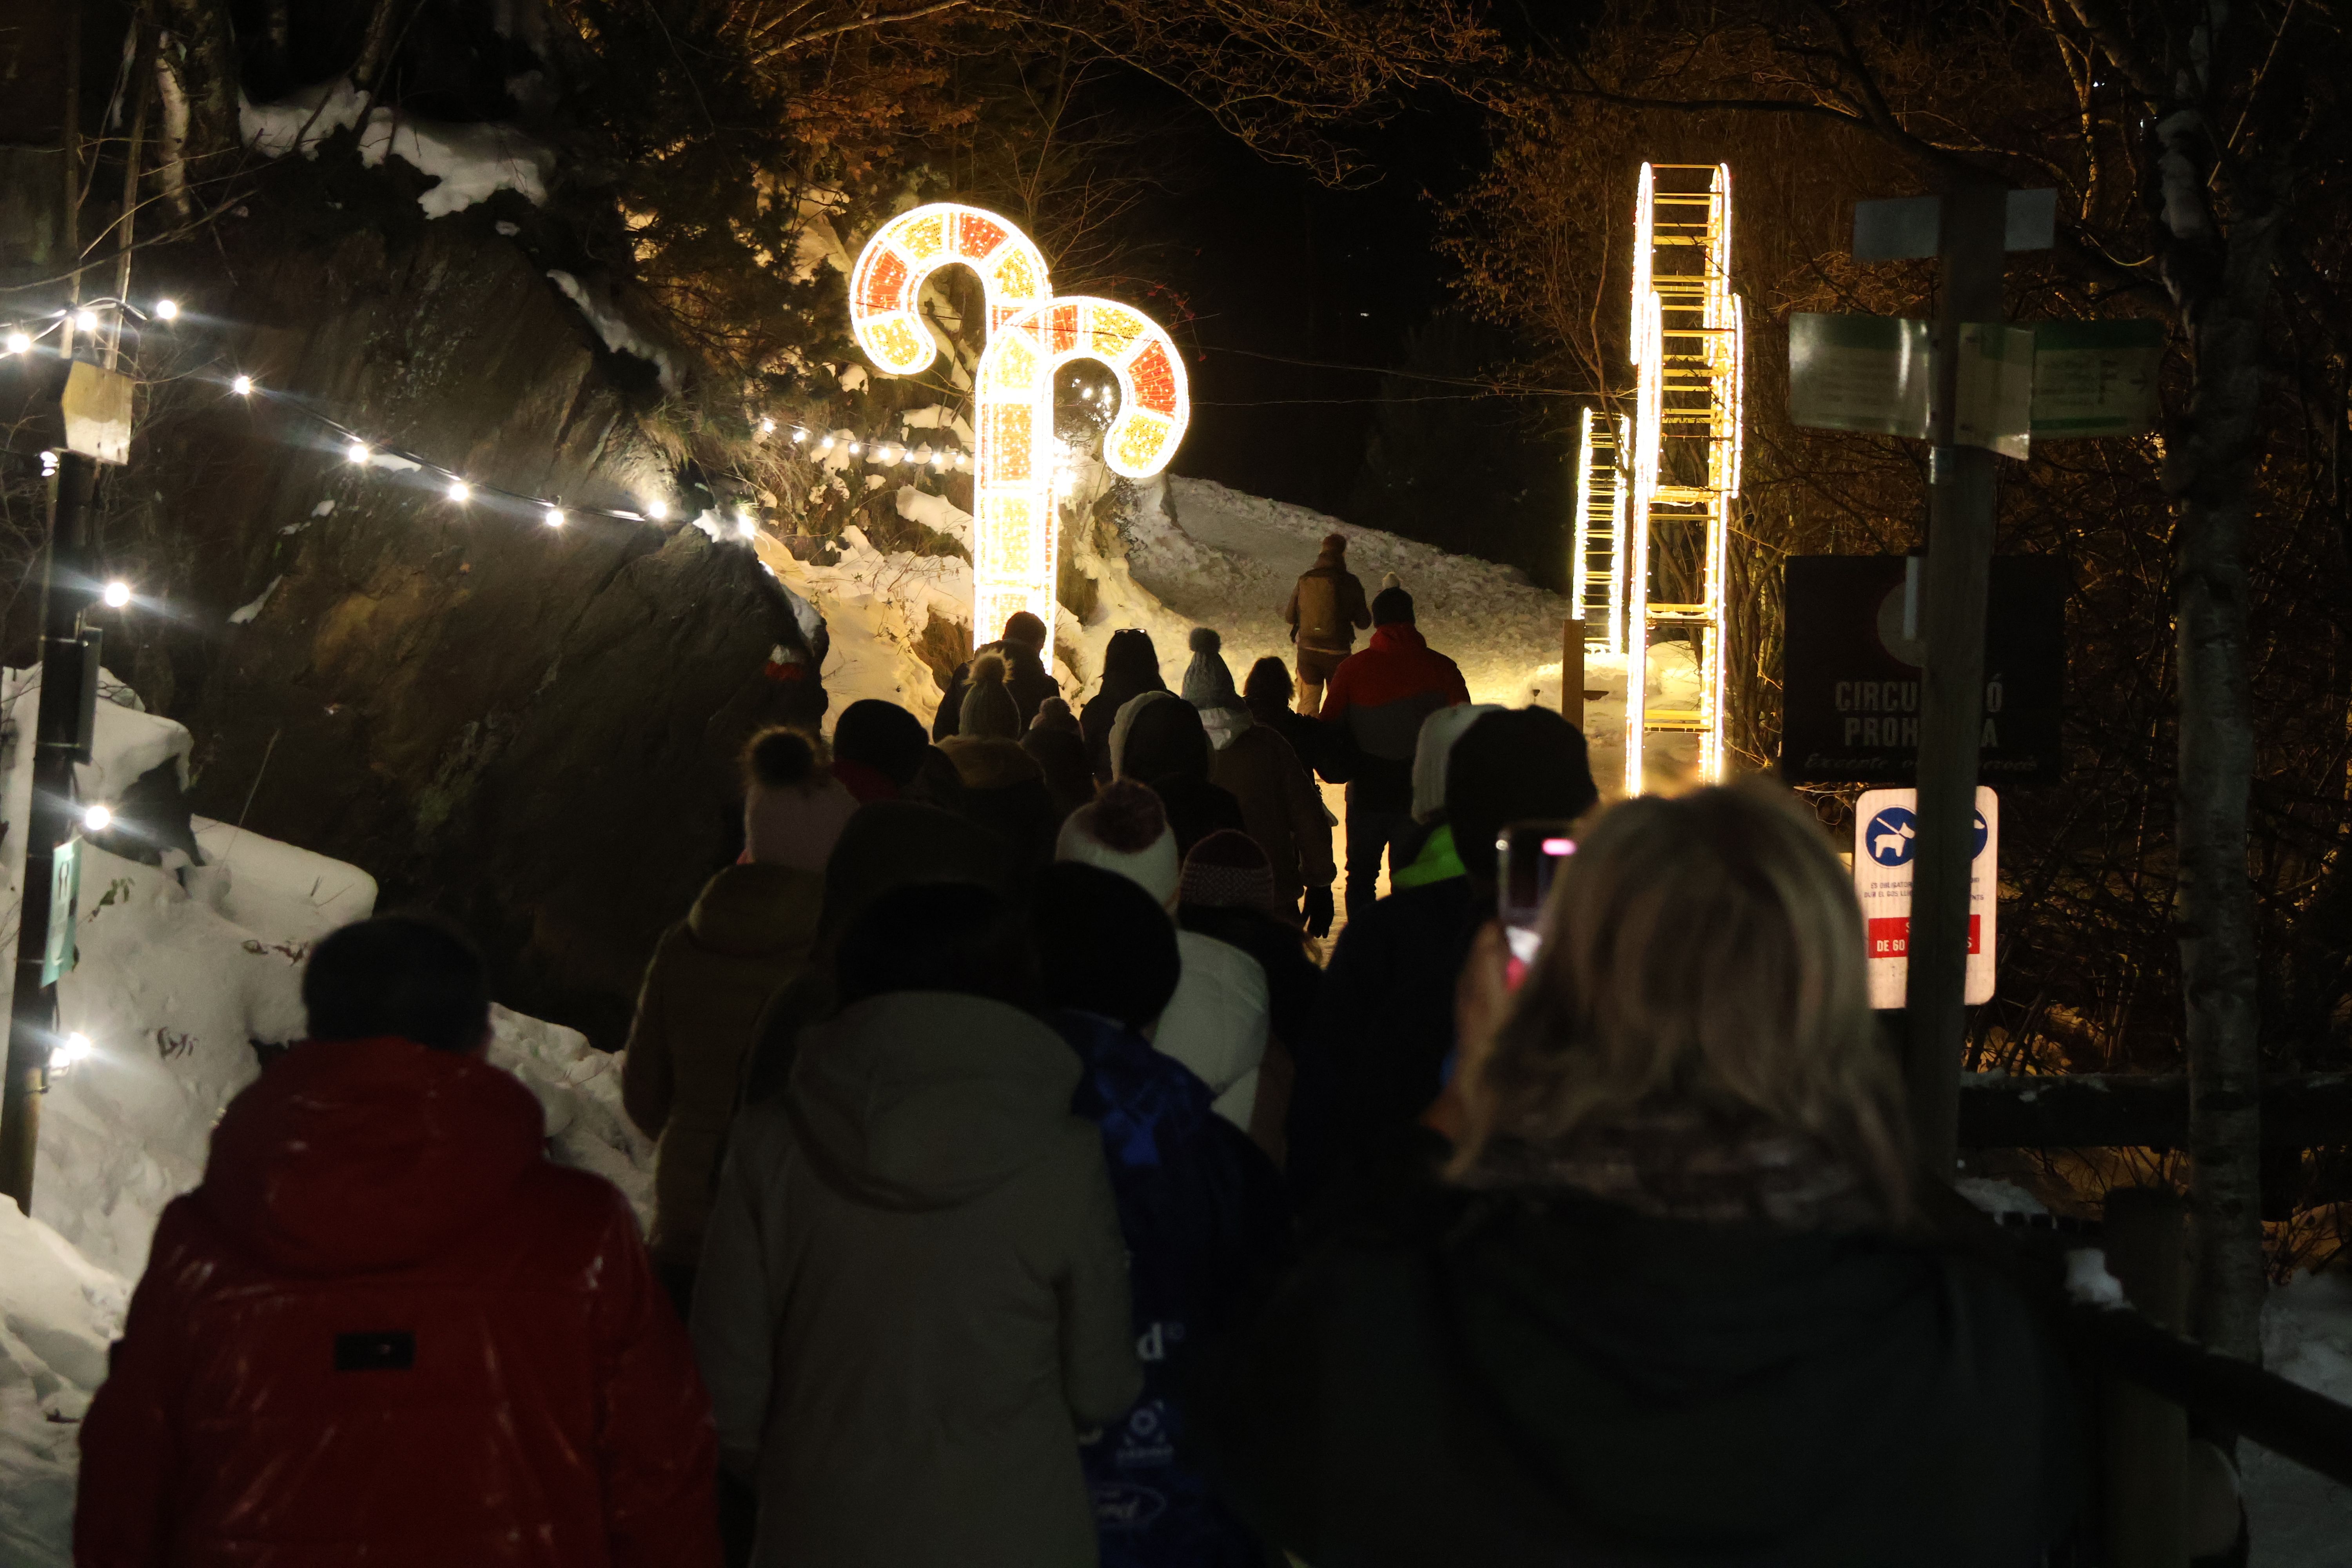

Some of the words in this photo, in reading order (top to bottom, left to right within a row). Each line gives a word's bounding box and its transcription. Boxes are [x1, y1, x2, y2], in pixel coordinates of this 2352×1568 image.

[1835, 672, 2003, 713] CIRCUÓ
[1844, 717, 1998, 746] PROHA
[1877, 939, 1889, 952] DE
[1893, 939, 1905, 951] 60
